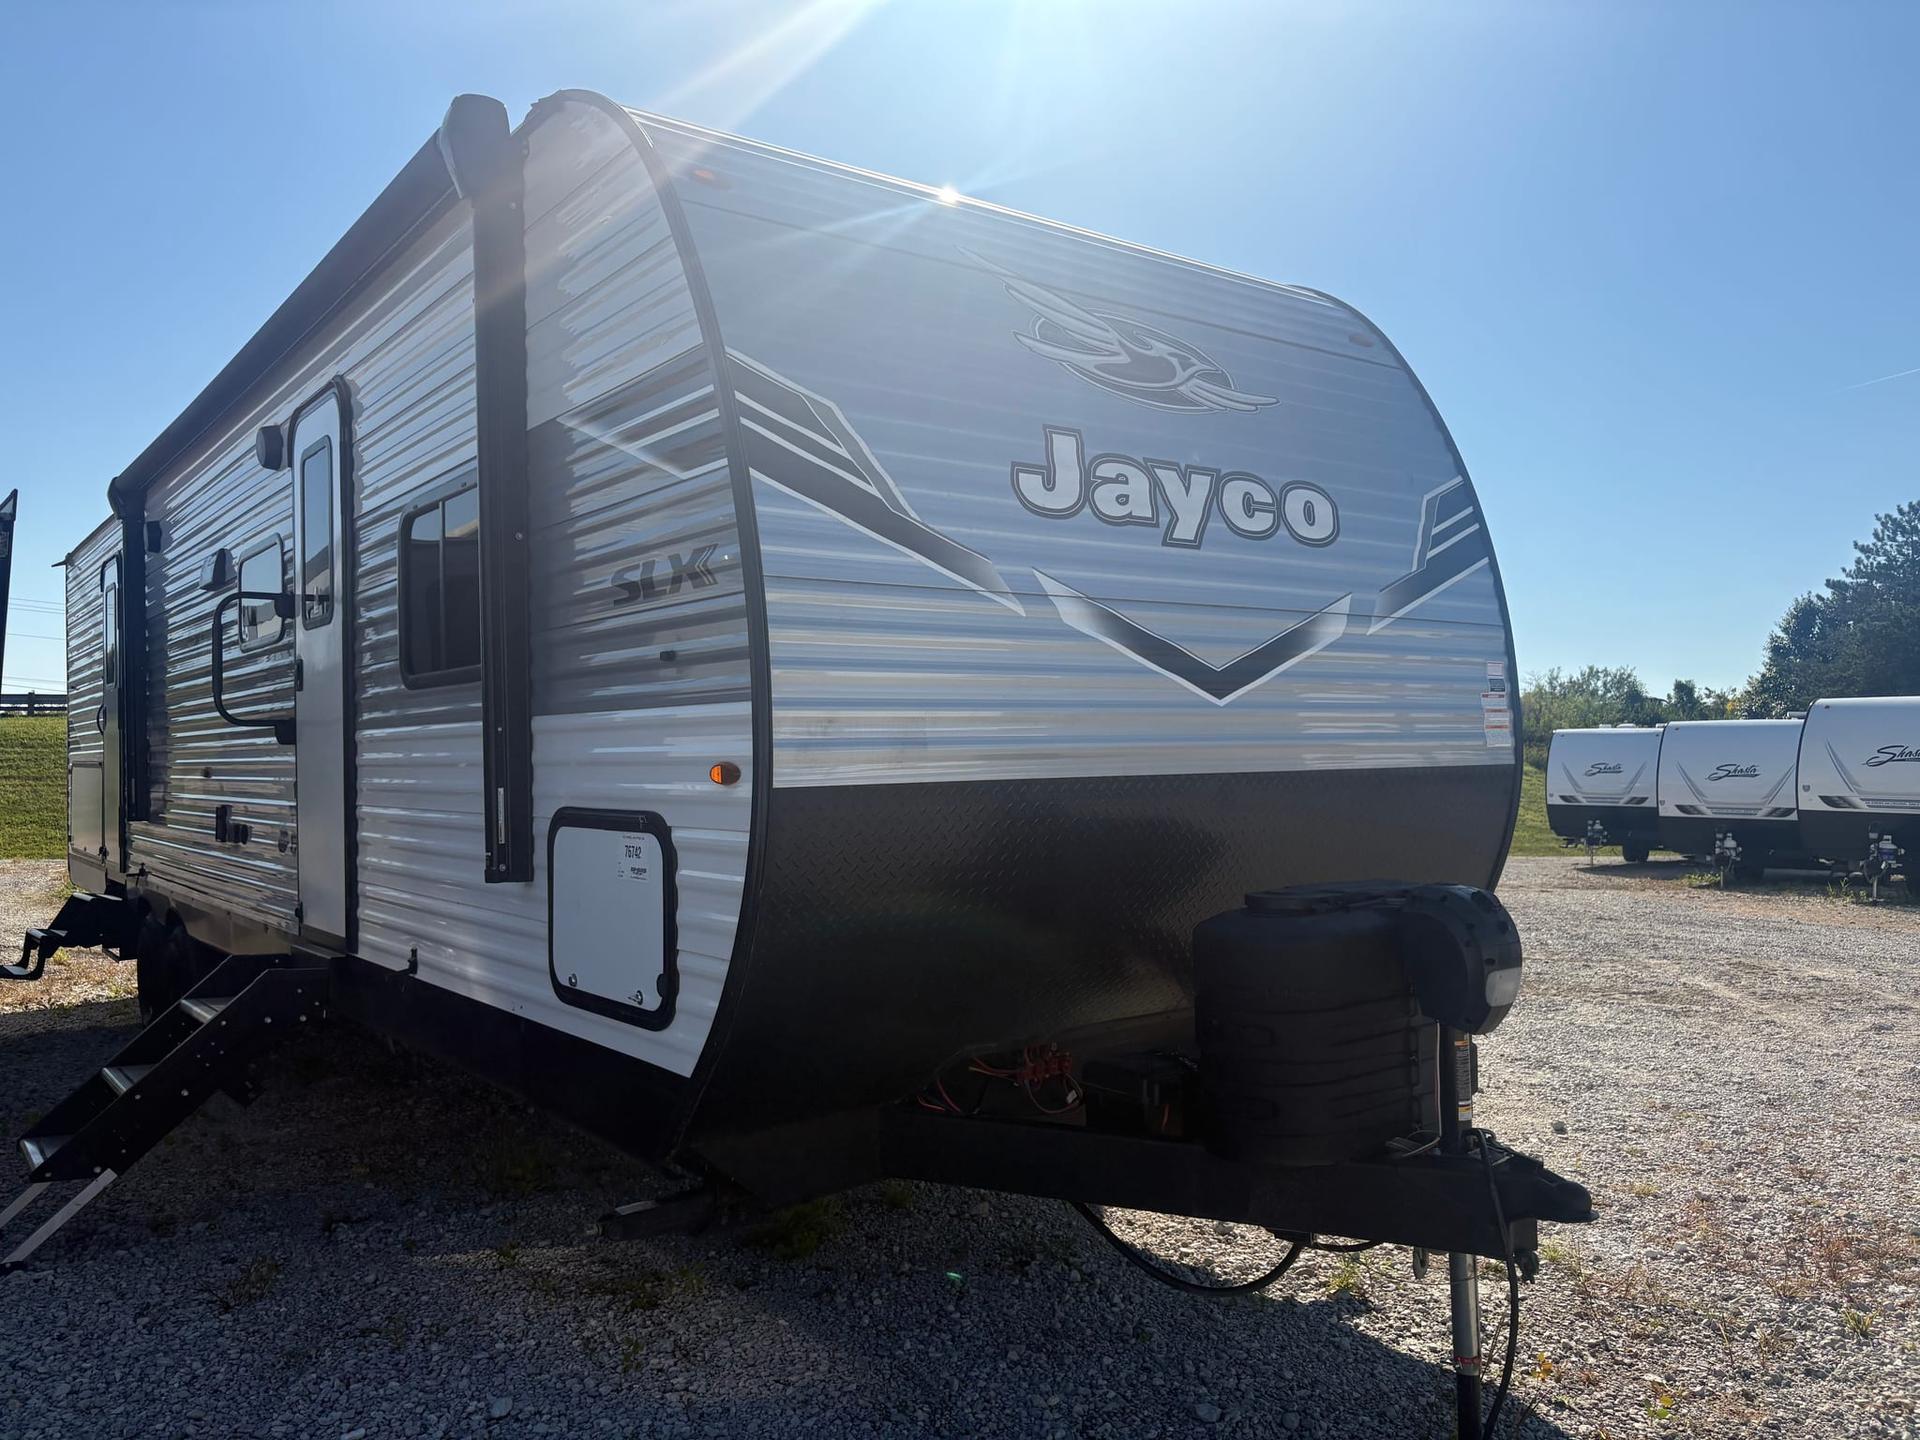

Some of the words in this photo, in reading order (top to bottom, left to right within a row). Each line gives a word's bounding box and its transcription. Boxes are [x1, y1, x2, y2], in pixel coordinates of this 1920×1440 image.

[1010, 423, 1340, 549] Jayco
[610, 543, 719, 606] SLK
[1584, 762, 1624, 776] Shasta
[1706, 764, 1761, 781] Shasta
[624, 844, 642, 859] 76742
